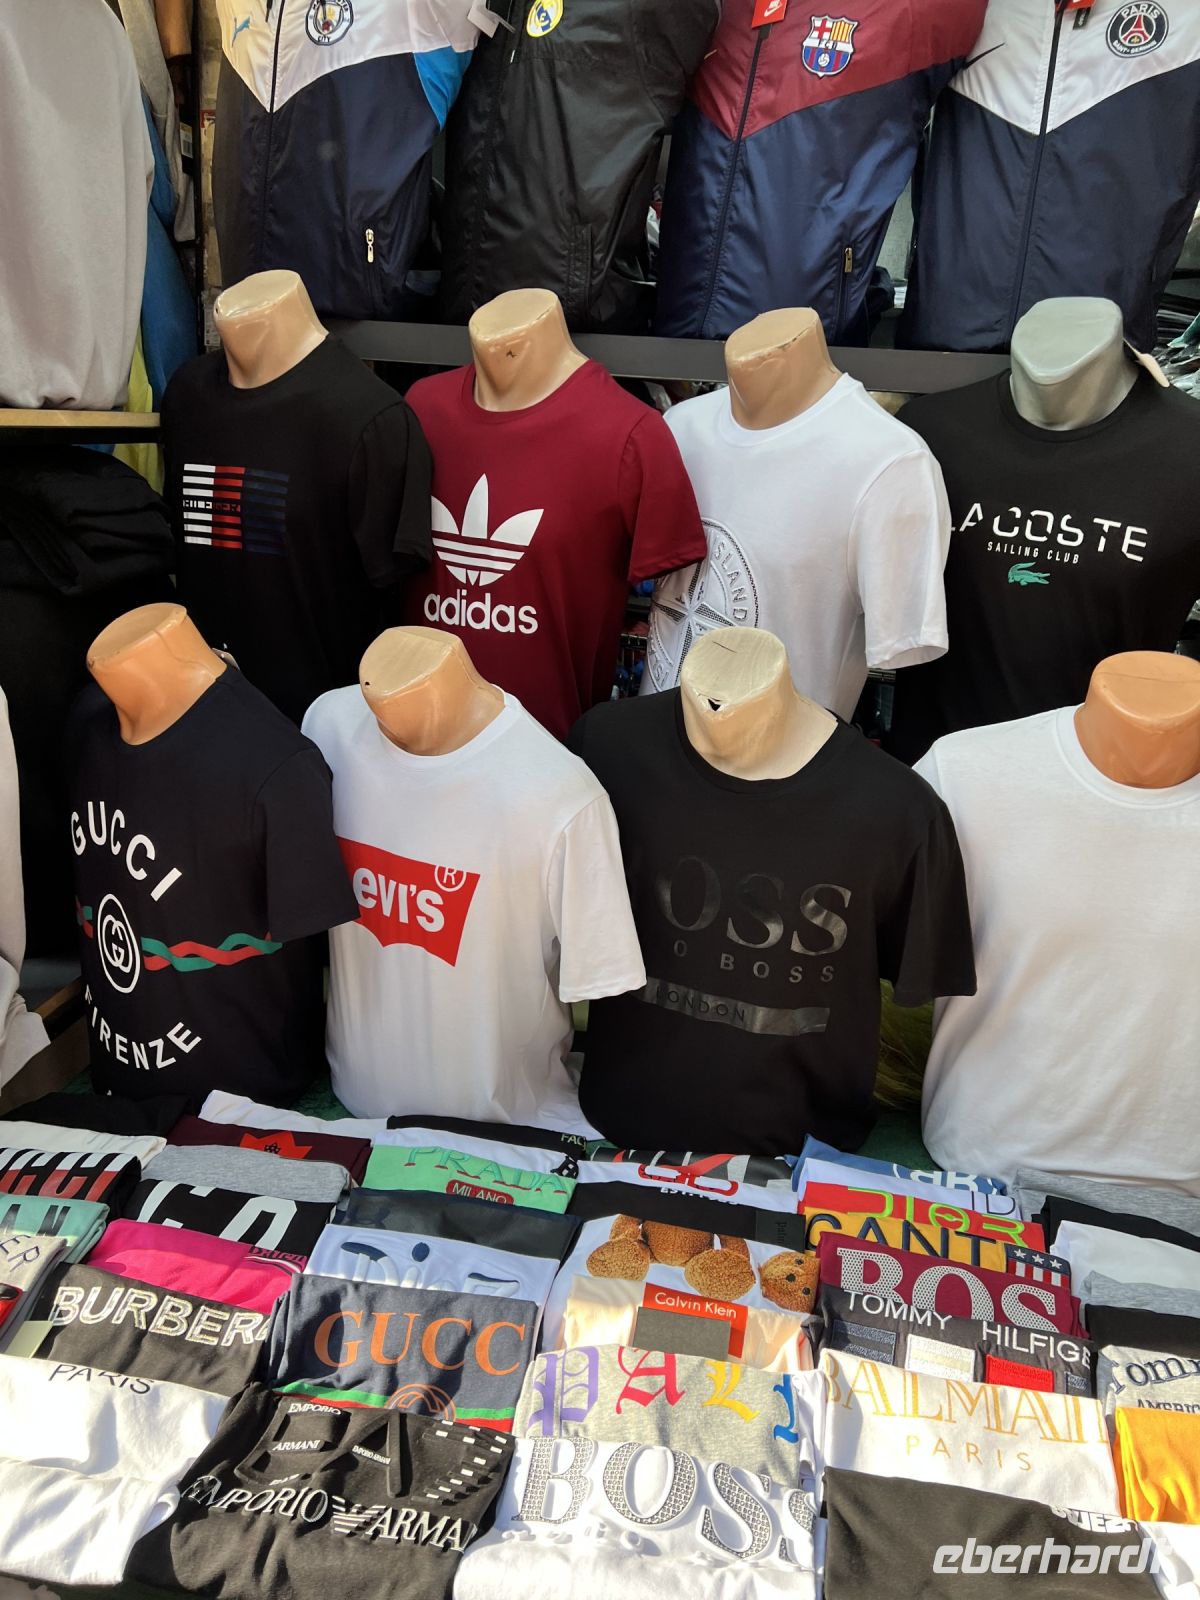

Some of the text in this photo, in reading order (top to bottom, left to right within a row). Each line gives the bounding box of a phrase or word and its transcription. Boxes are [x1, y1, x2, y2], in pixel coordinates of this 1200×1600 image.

[1121, 4, 1160, 19] PARIS
[951, 502, 1148, 562] ACOSTE
[987, 541, 1080, 564] SAILING CLUB
[424, 589, 538, 634] adidas
[70, 801, 182, 902] GUCCI
[720, 952, 835, 983] BOSS
[656, 986, 746, 1022] LONDON
[654, 1292, 737, 1319] Calvin Klein
[844, 1289, 953, 1331] TOMMY
[313, 1309, 527, 1376] GUCC
[48, 1363, 155, 1395] PARIS
[822, 1350, 1109, 1444] BALMAI
[287, 1402, 342, 1415] EMPORIO
[272, 1439, 321, 1451] ARMANI
[906, 1436, 1032, 1473] PARIS
[182, 1474, 329, 1523] EMPORIO
